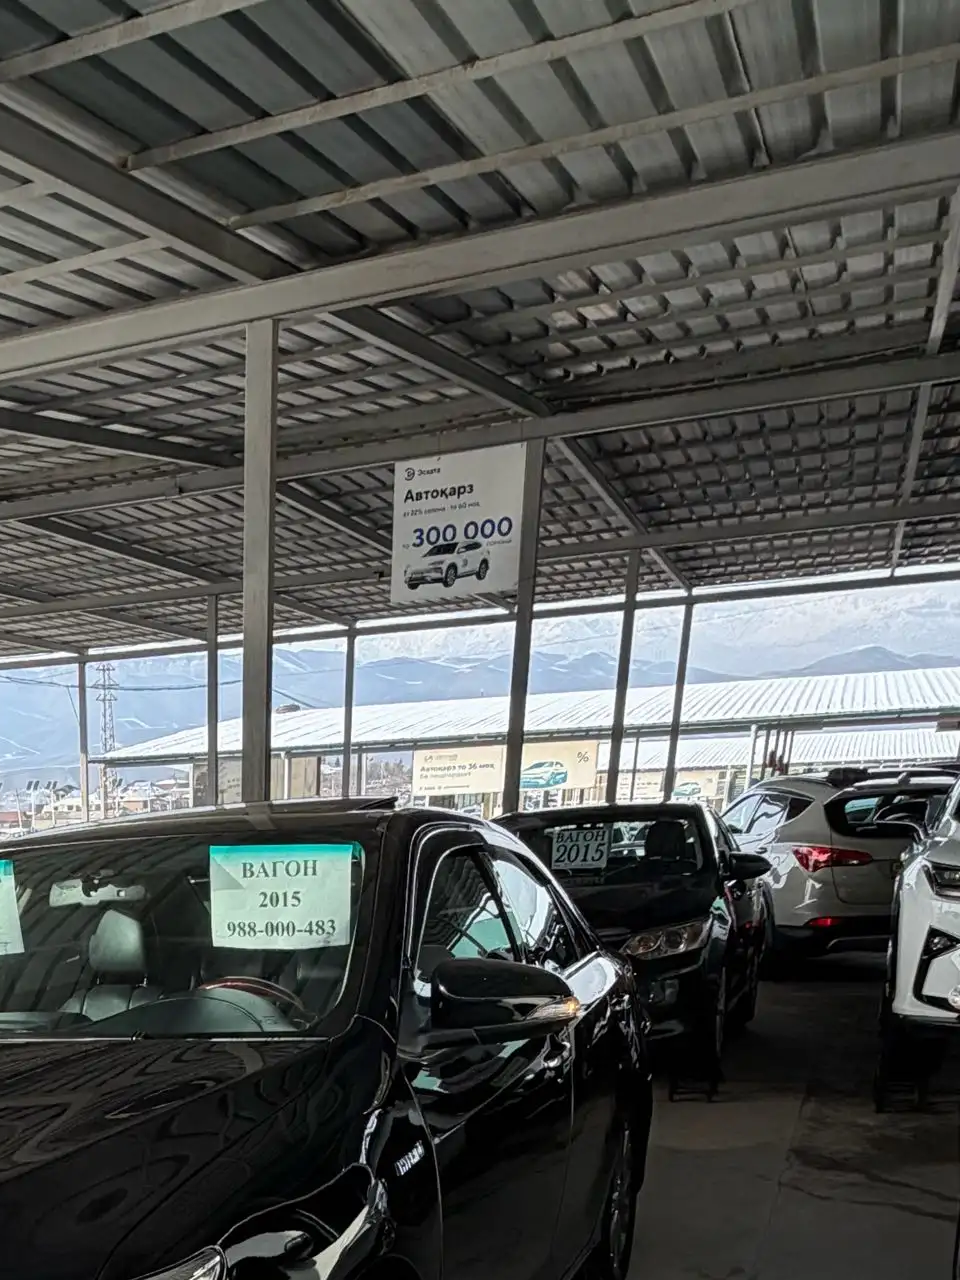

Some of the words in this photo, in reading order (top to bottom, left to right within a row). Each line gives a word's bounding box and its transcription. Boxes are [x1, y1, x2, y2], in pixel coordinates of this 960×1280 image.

[404, 484, 474, 503] Автоқарз
[412, 524, 457, 548] 300
[464, 516, 513, 541] 000
[556, 829, 607, 844] ВАГОН
[554, 842, 607, 863] 2015
[241, 859, 319, 879] ВАГОН
[258, 890, 302, 908] 2015
[226, 918, 337, 938] 988-000-483
